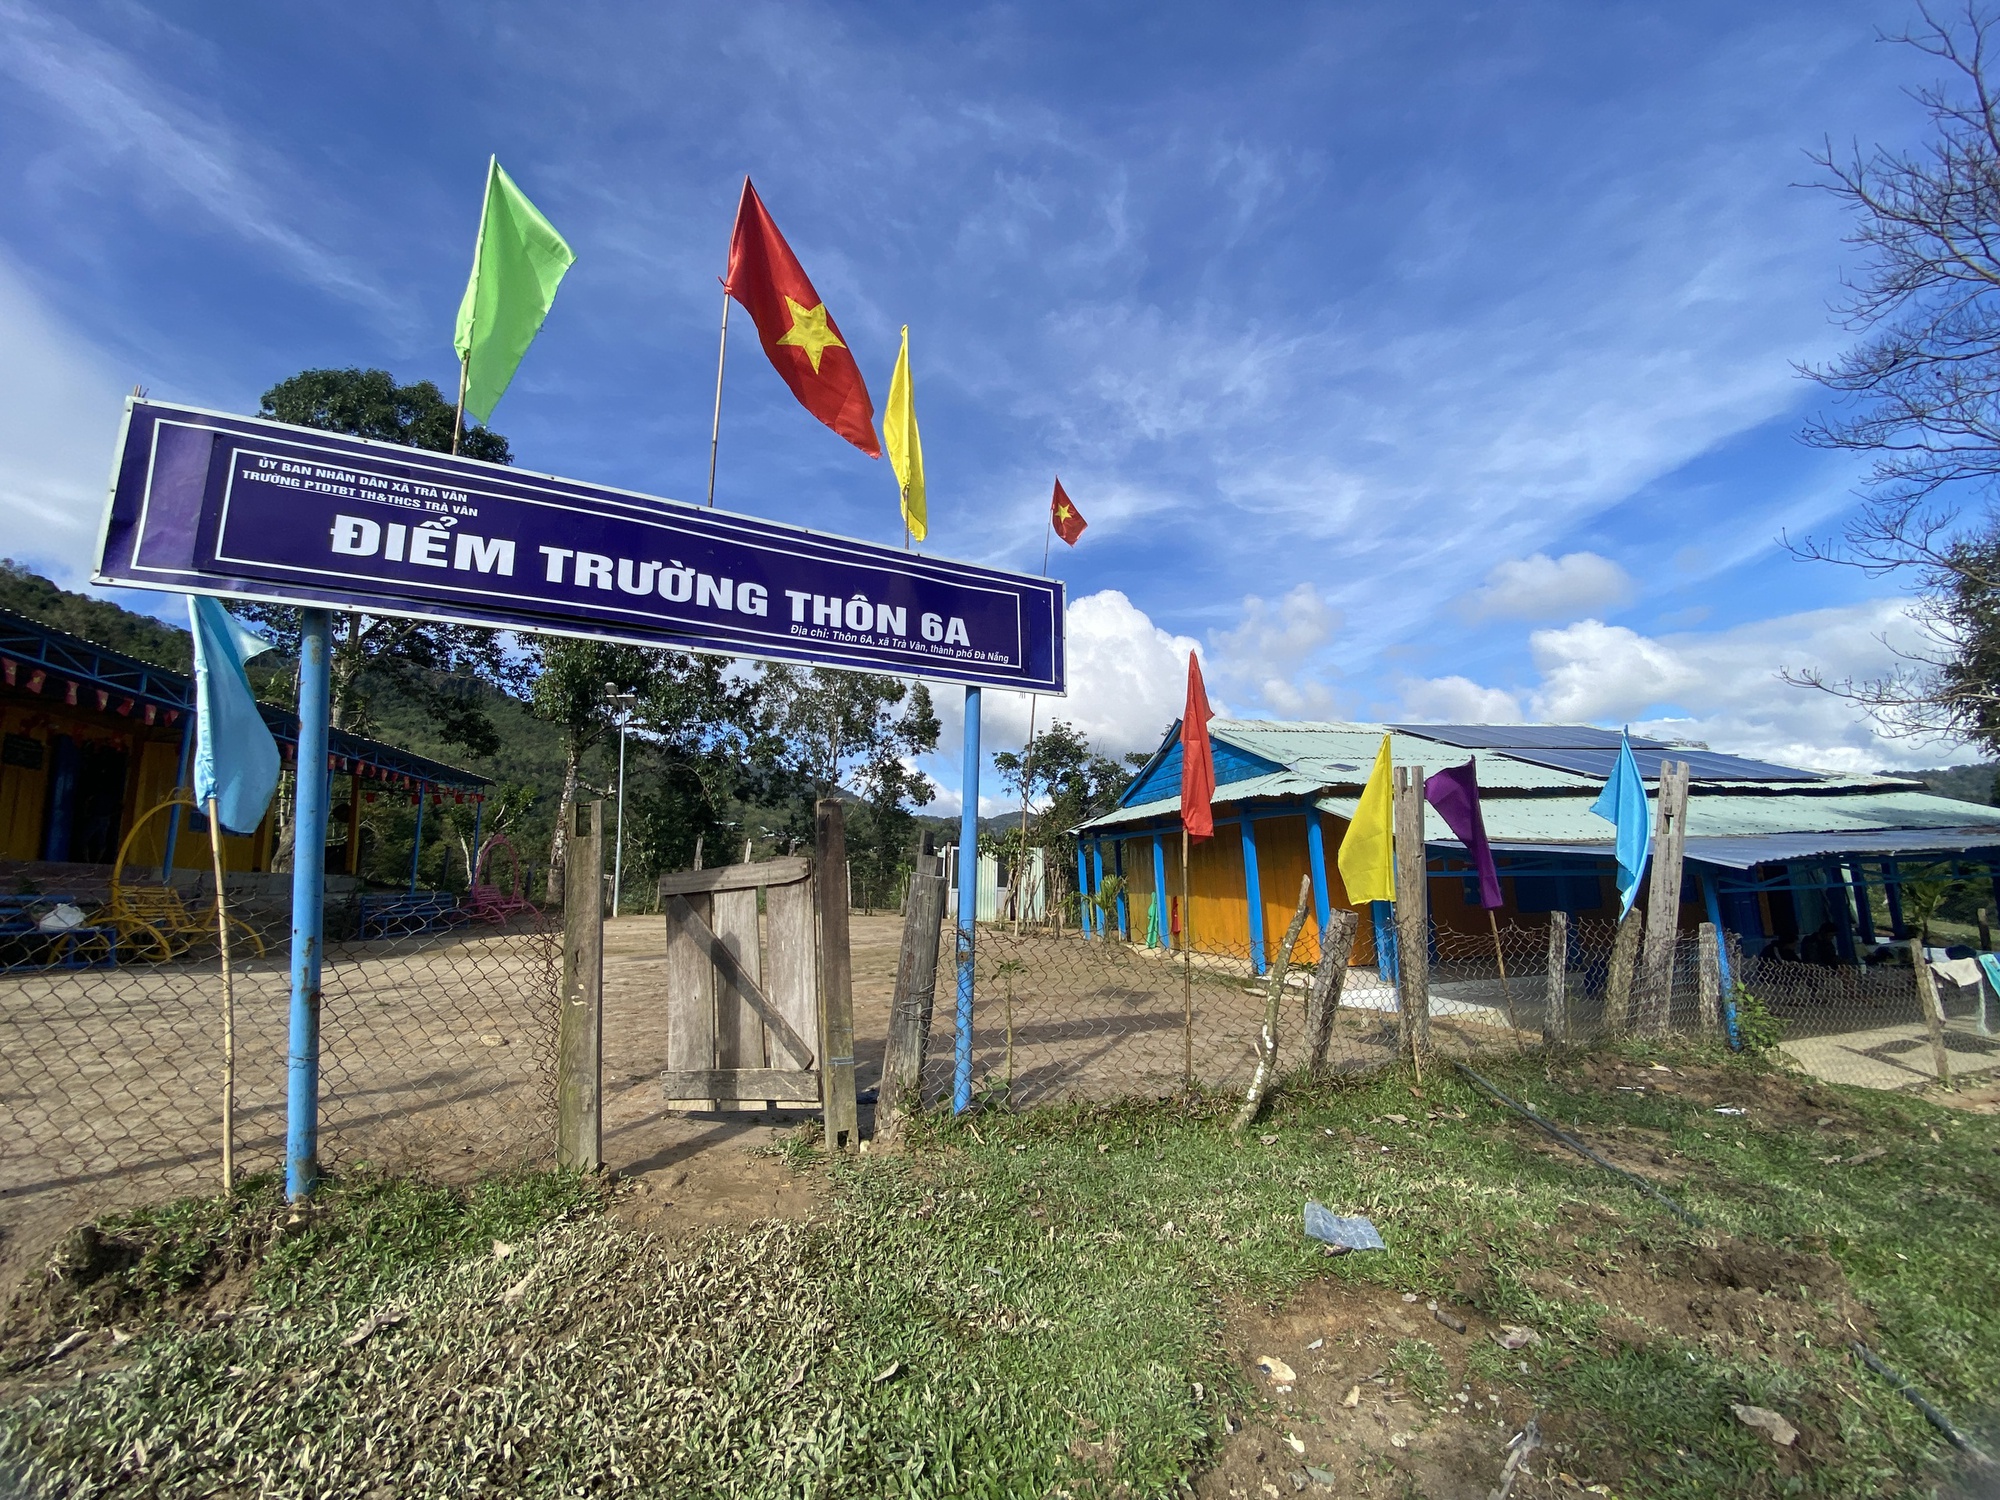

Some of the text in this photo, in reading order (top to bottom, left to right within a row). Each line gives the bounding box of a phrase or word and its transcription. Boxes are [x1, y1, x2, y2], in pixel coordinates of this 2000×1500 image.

[242, 469, 478, 517] TRƯỜNG PTDTBT TH&THCS TRÀ VÂN
[258, 456, 467, 503] ỦY BAN NHÂN DÂN XÃ TRÀ VÂN
[329, 514, 971, 647] ĐIỂM TRƯỜNG THÔN 6A
[790, 624, 808, 636] Địa
[810, 628, 830, 639] chỉ:
[832, 630, 857, 643] Thôn
[860, 634, 875, 646] 6A,
[878, 637, 890, 647] xã
[892, 638, 907, 649] Trà
[930, 644, 954, 656] thành
[956, 648, 973, 658] phố
[974, 650, 986, 660] Đà
